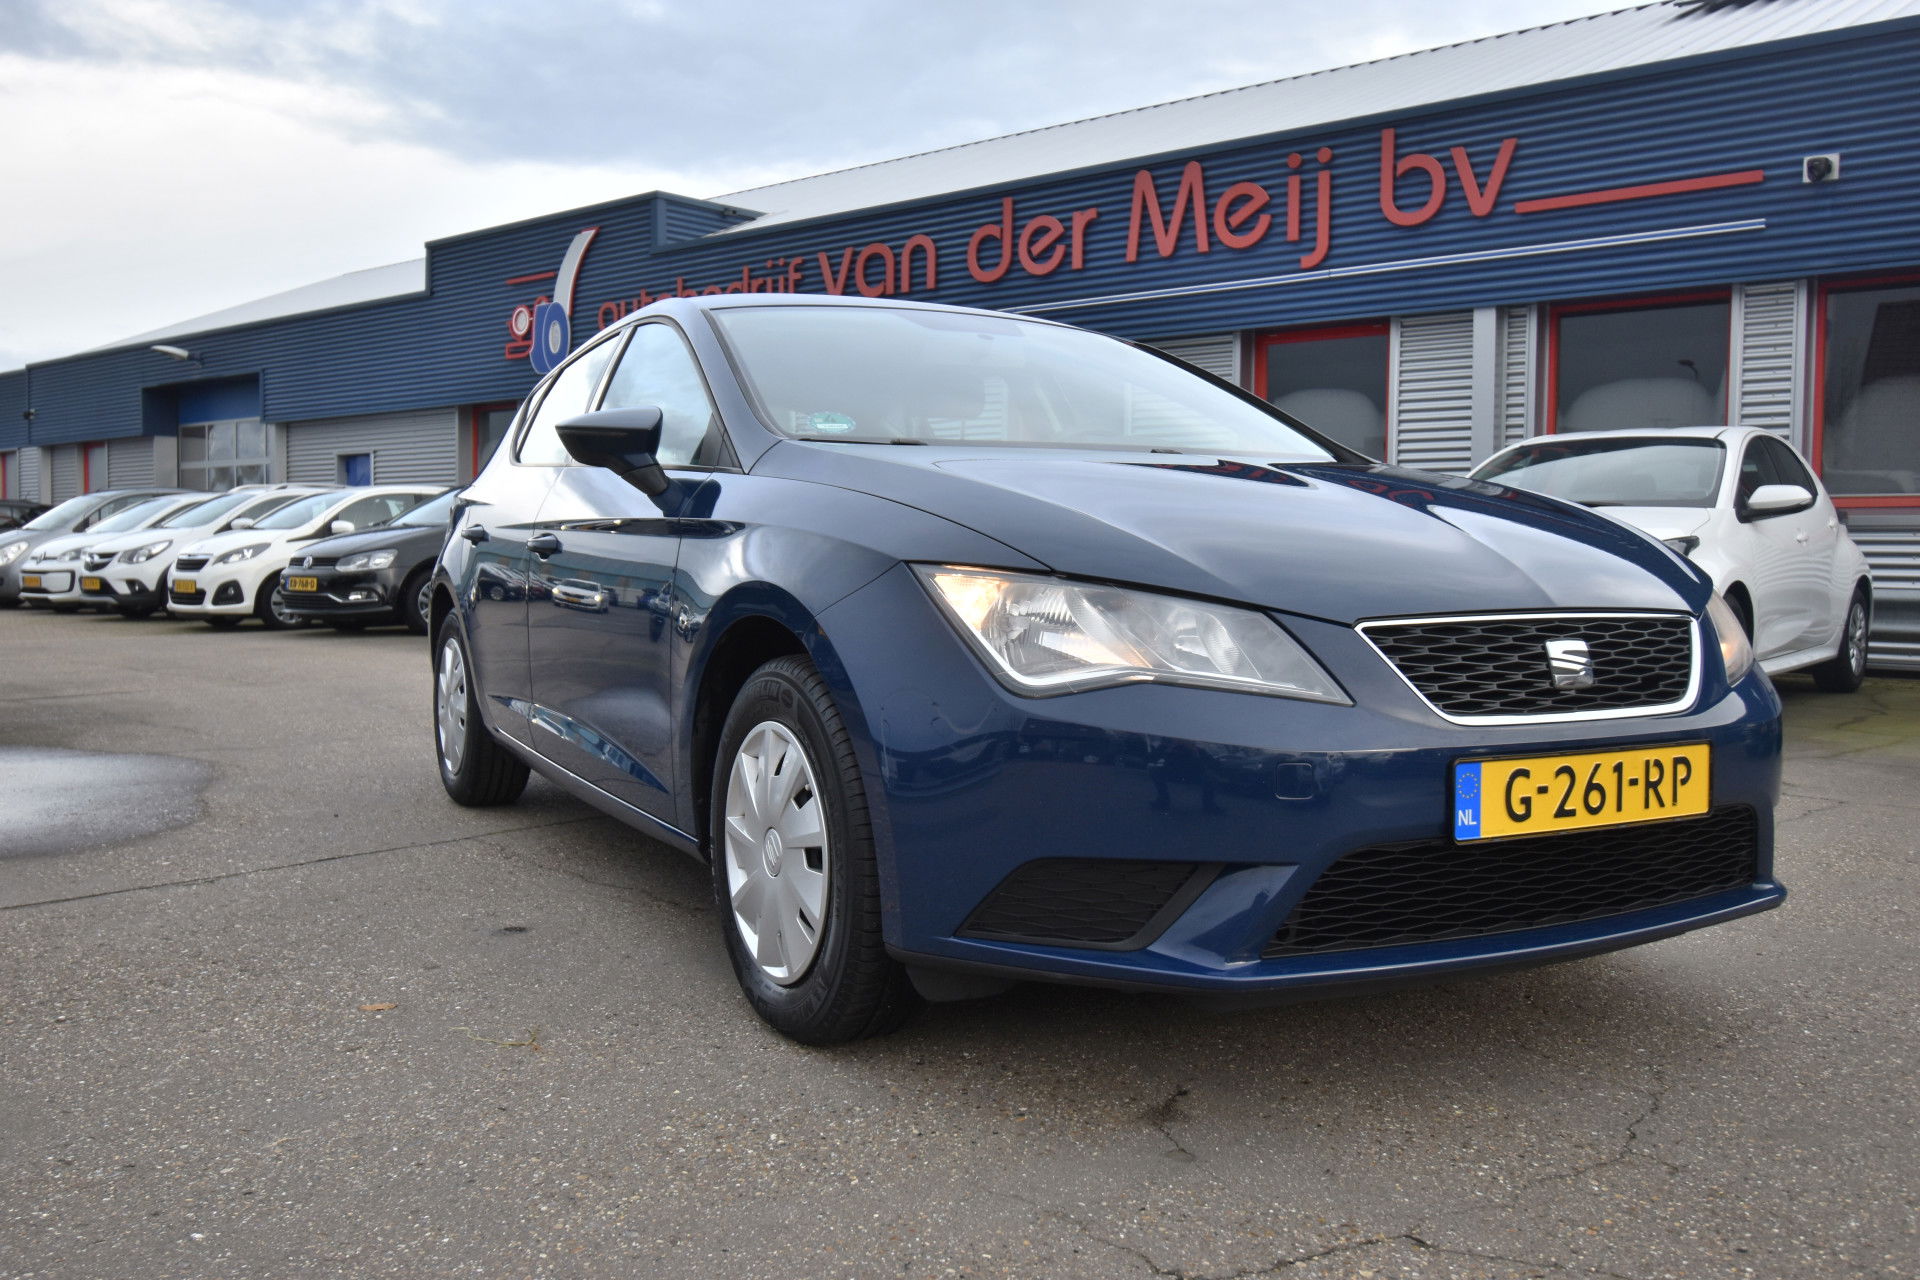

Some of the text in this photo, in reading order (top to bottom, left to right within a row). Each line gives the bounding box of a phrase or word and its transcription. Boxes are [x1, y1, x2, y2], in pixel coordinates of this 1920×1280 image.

[597, 127, 1518, 330] autbdrijf van der Meij bv
[1457, 809, 1477, 827] NL
[1505, 755, 1692, 823] G-261-RP
